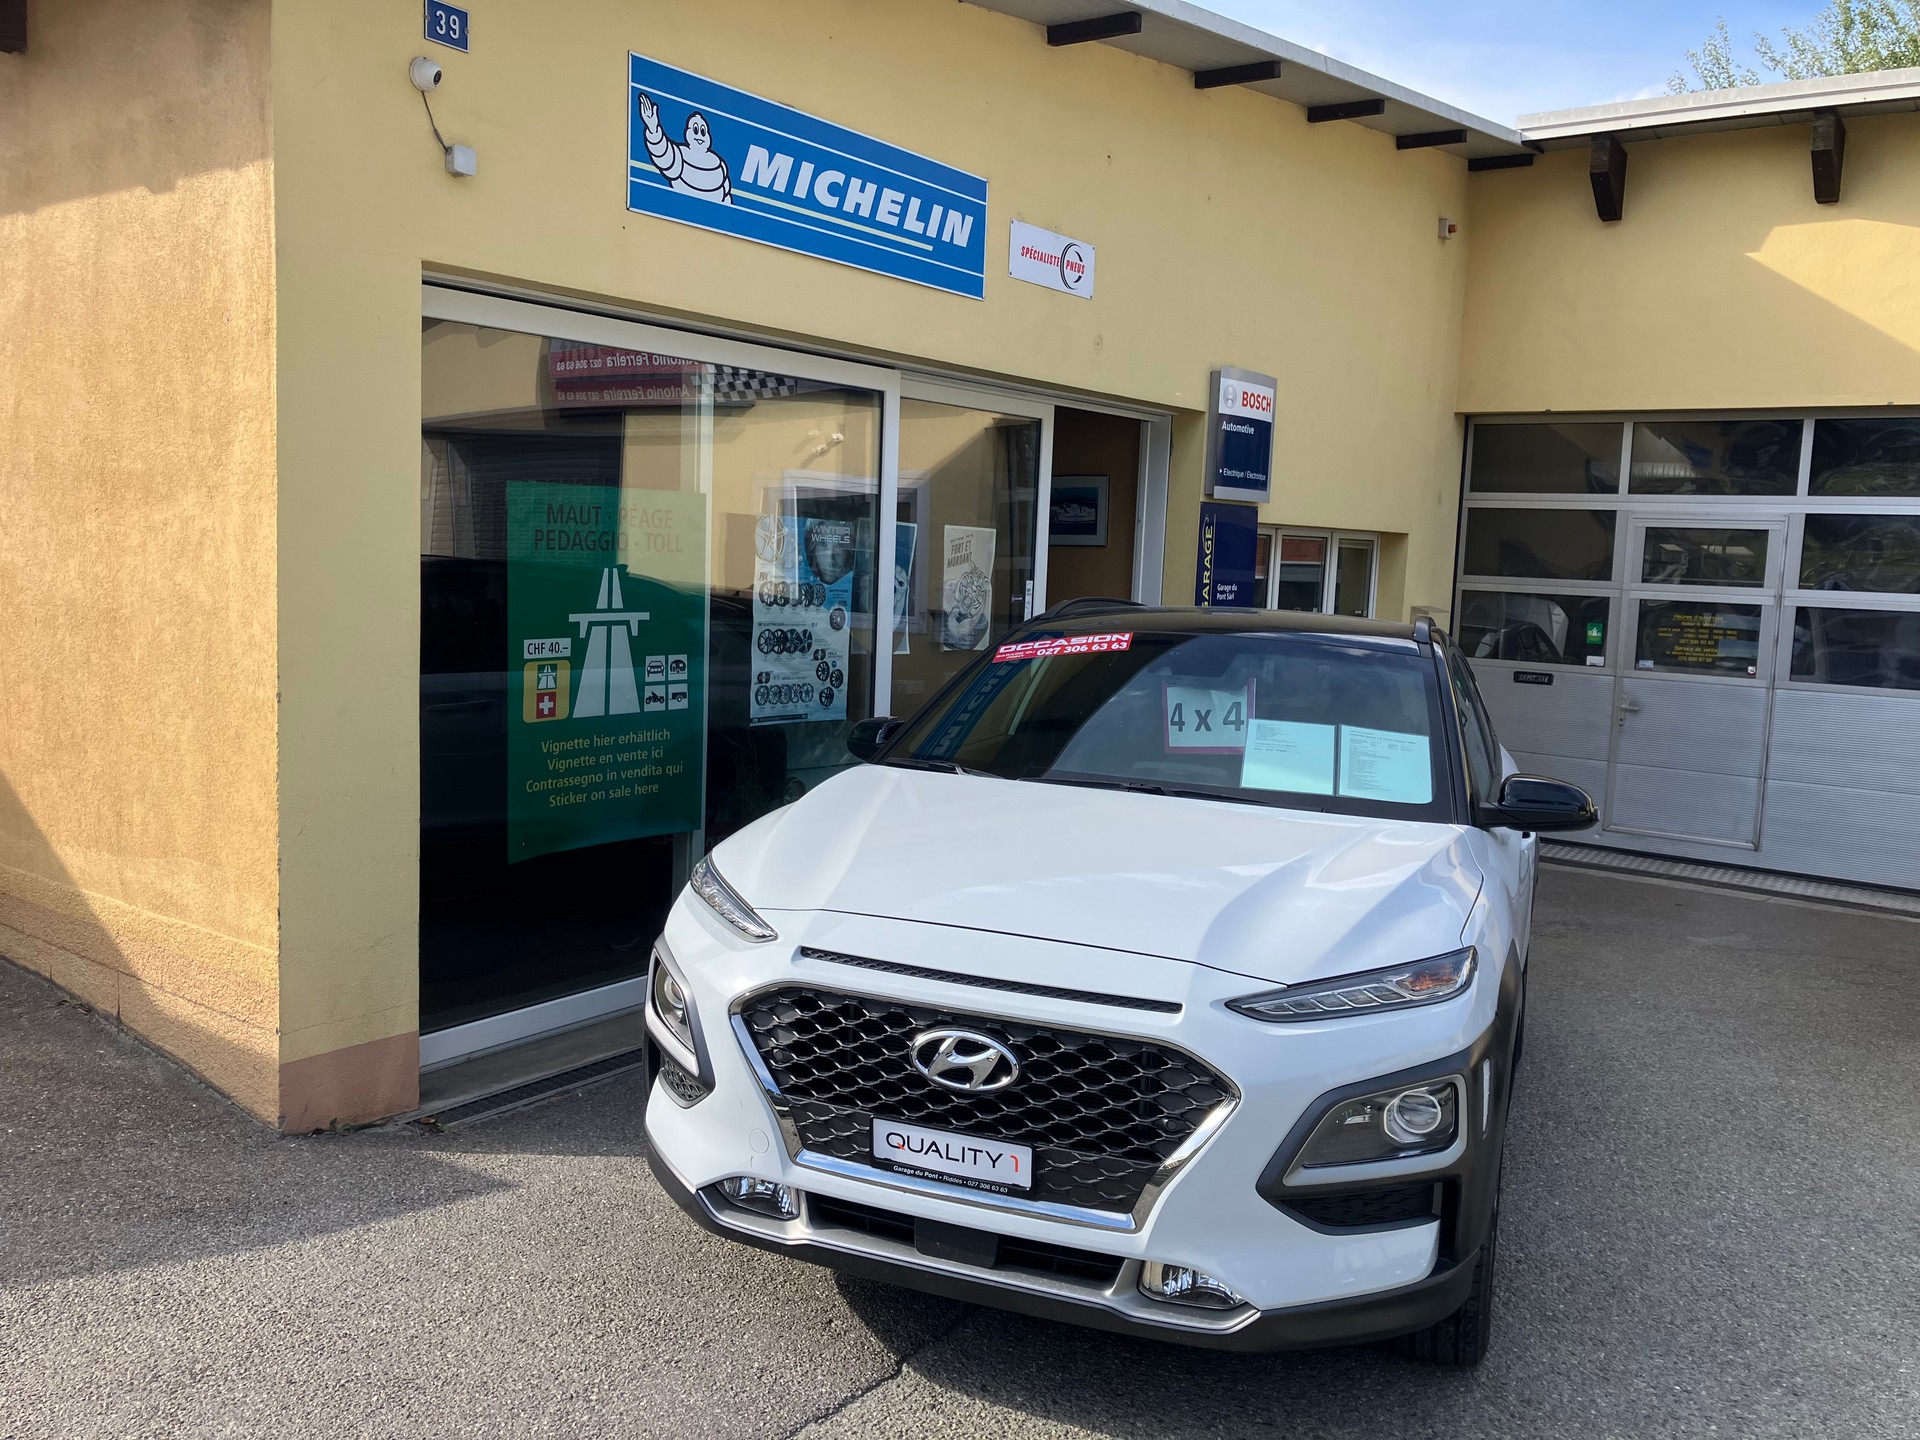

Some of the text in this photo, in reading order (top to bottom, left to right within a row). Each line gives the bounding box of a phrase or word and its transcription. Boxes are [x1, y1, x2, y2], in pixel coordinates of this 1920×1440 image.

[436, 10, 459, 39] 39
[740, 144, 974, 248] MICHELIN
[1021, 245, 1085, 275] SPÉCIALISTE PNEUS
[1242, 390, 1271, 413] BOSCH
[1221, 420, 1255, 435] Automotive
[1223, 467, 1244, 479] Electrique
[546, 504, 673, 529] MAUT PÉAGE
[534, 529, 683, 553] PEDAGGIO TOLL
[811, 534, 850, 544] WHEELS
[951, 540, 972, 555] FORT ET
[1217, 584, 1232, 593] Garage
[527, 643, 546, 655] CHF
[1000, 633, 1129, 653] OCCASION
[1036, 647, 1062, 656] 027
[1064, 645, 1088, 653] 306
[1170, 701, 1244, 732] 4 x 4
[541, 728, 671, 755] Vignette hier erhältlich
[547, 746, 663, 773] Vignette en vente ici
[526, 761, 683, 793] Contrassegno in vendita qui
[549, 782, 659, 807] Sticker on sale here
[886, 1131, 1004, 1169] QUALITY
[893, 1165, 1008, 1194] Garage du Pont Riddes 027 306 63 63
